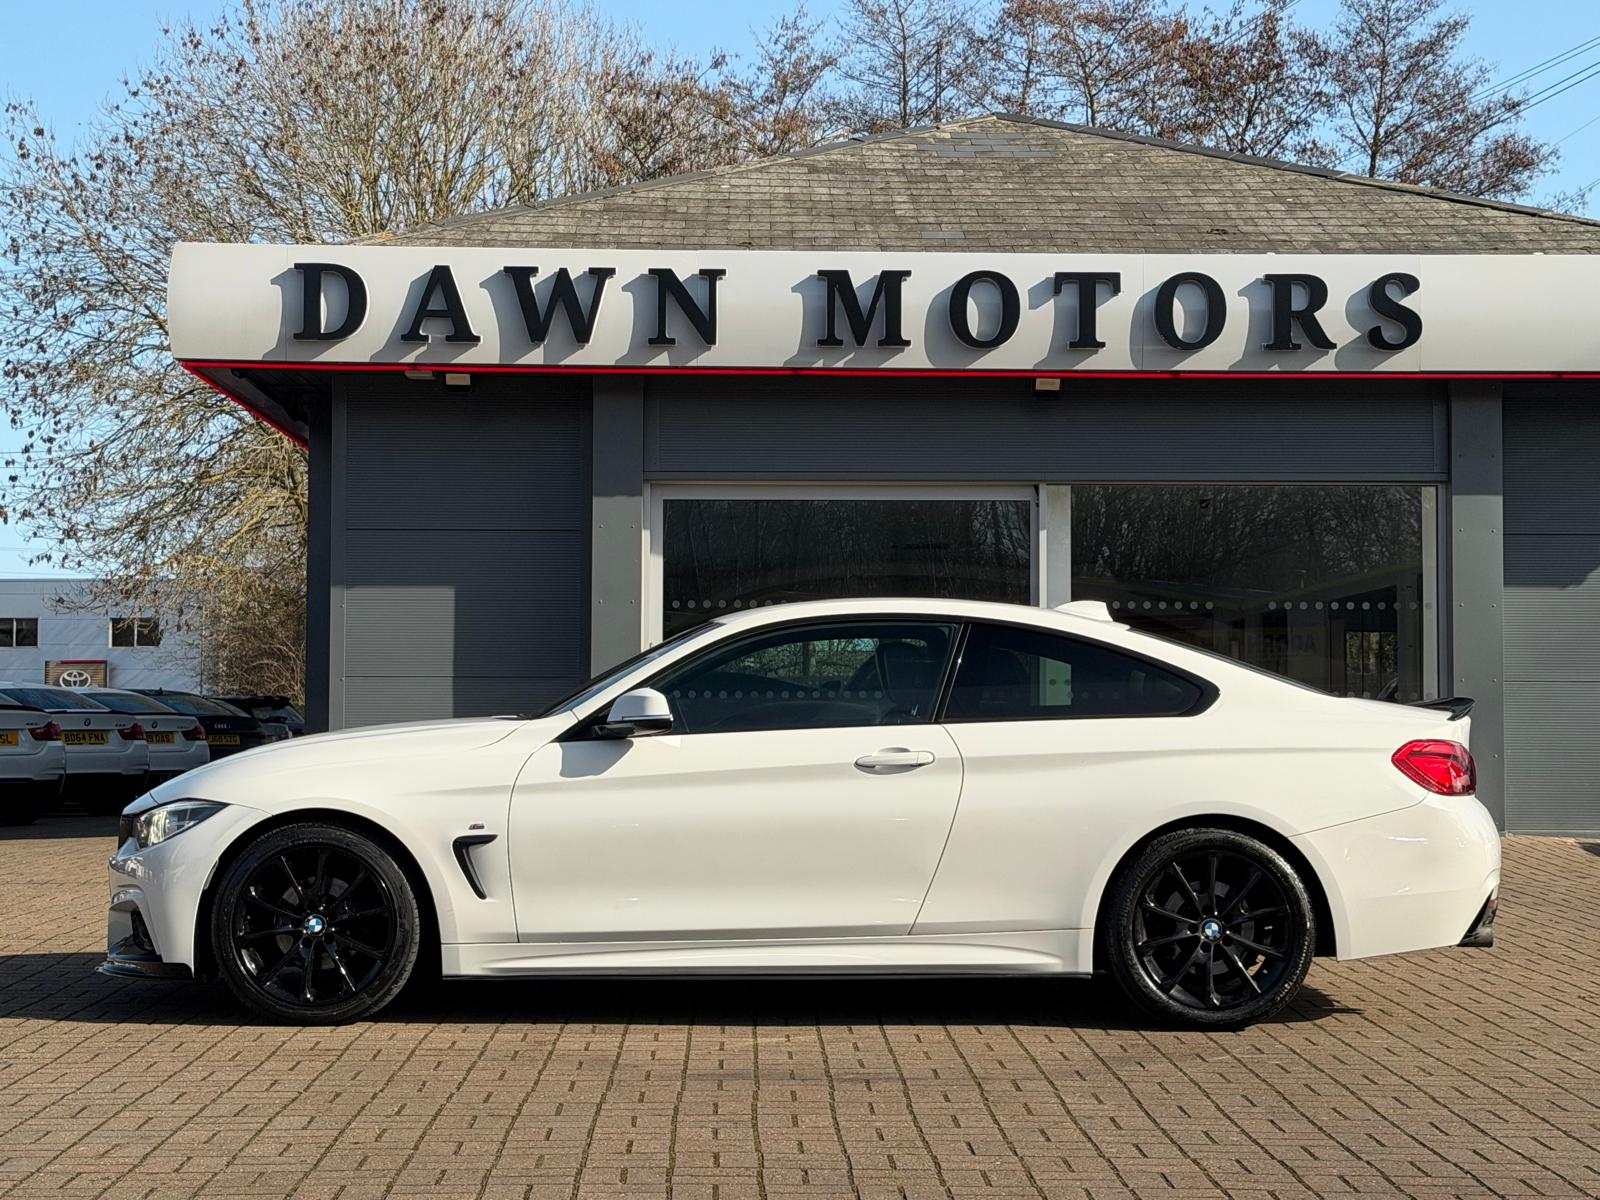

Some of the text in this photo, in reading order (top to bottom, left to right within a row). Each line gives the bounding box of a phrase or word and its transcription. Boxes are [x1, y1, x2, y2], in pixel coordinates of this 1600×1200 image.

[293, 262, 1423, 351] DAWN MOTORS
[64, 732, 105, 742] BD64 FNA
